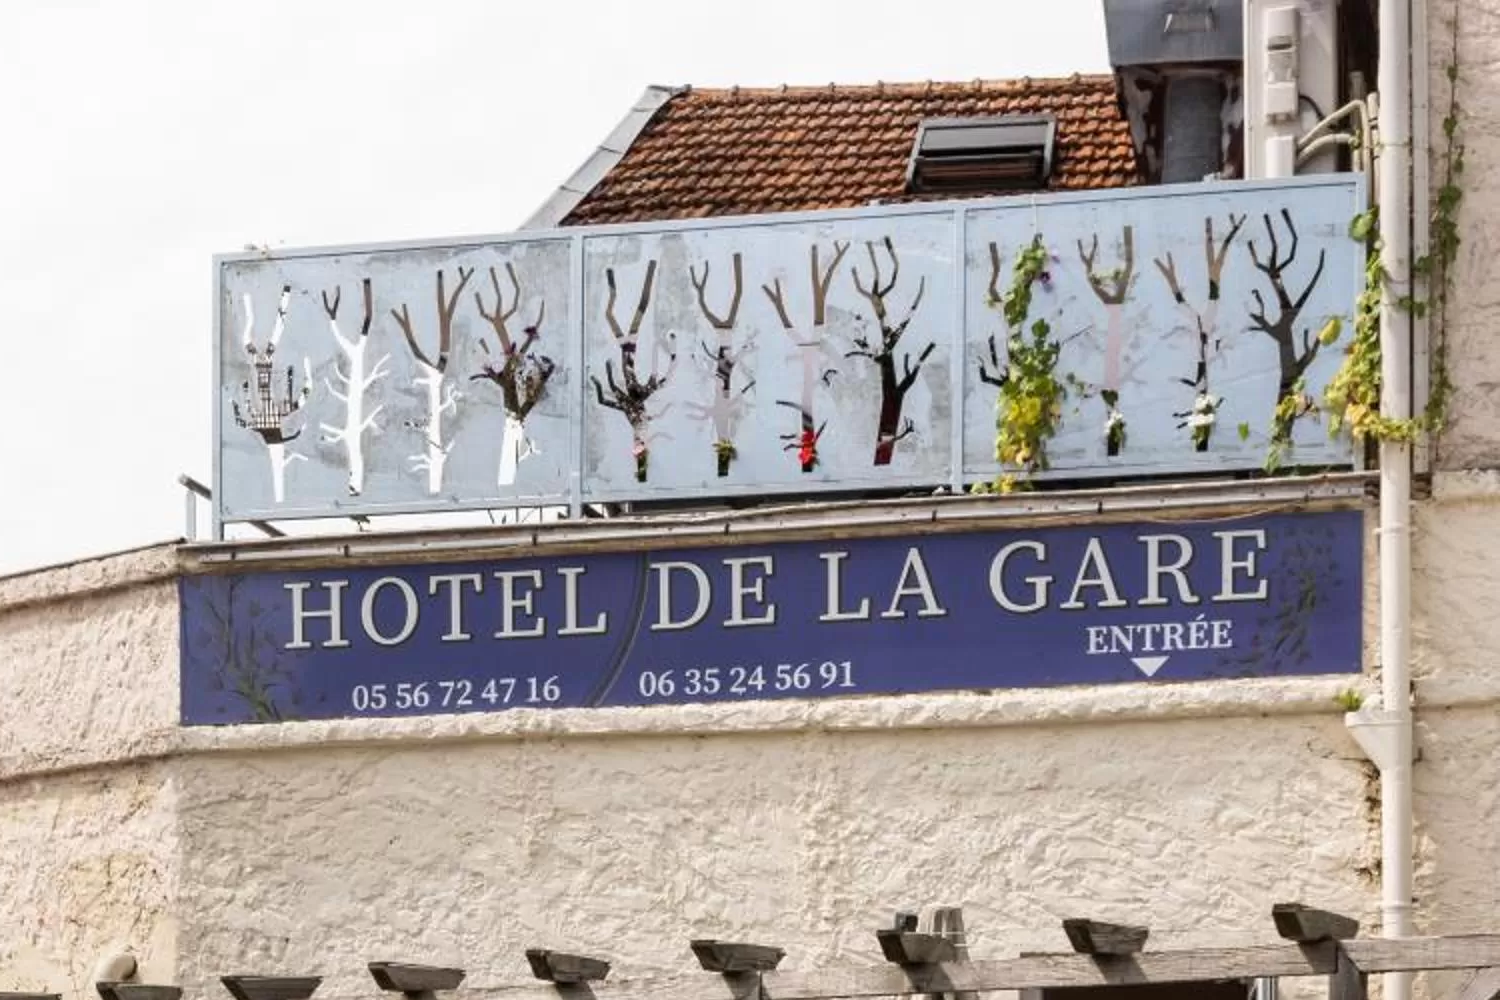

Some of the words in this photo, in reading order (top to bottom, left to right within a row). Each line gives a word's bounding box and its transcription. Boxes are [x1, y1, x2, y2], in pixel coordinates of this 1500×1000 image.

[283, 566, 608, 649] HOTEL
[650, 555, 776, 631] DE
[818, 546, 947, 622] LA
[988, 528, 1269, 613] GARE
[1085, 613, 1233, 655] ENTRÉE
[351, 684, 387, 711] 05
[395, 682, 430, 709] 56
[438, 679, 473, 707] 72
[481, 677, 517, 705] 47
[526, 675, 561, 703] 16
[638, 669, 675, 697] 06
[684, 668, 722, 695] 35
[729, 665, 767, 693] 24
[774, 663, 811, 690] 56
[819, 660, 857, 689] 91
